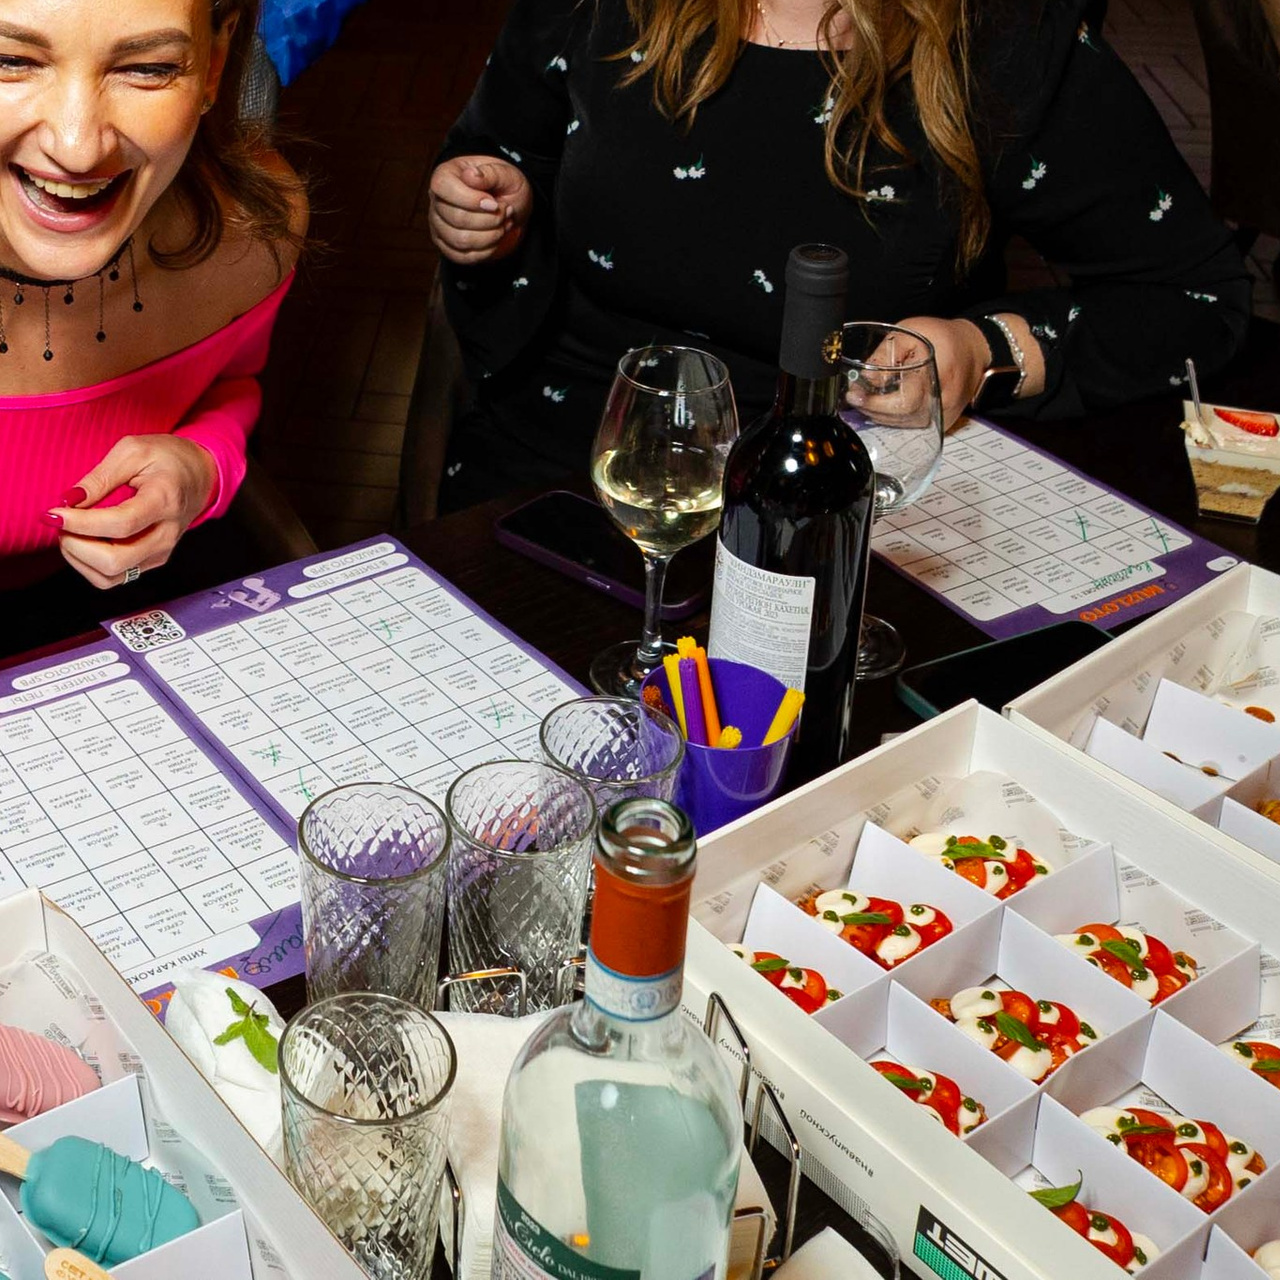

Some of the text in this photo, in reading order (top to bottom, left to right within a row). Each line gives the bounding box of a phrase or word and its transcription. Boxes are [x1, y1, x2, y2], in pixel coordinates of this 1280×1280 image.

[338, 563, 379, 579] ПИТЕРЕ
[17, 653, 112, 687] @MUZLOTO.SPB
[51, 673, 98, 692] ПИТЕРЕ
[8, 689, 45, 706] ПЕТЬ!
[200, 887, 245, 907] МИХАЙЛОВ
[217, 897, 240, 909] СТАС
[176, 947, 207, 964] ХИТЫ
[799, 1109, 874, 1178] #навыпускной
